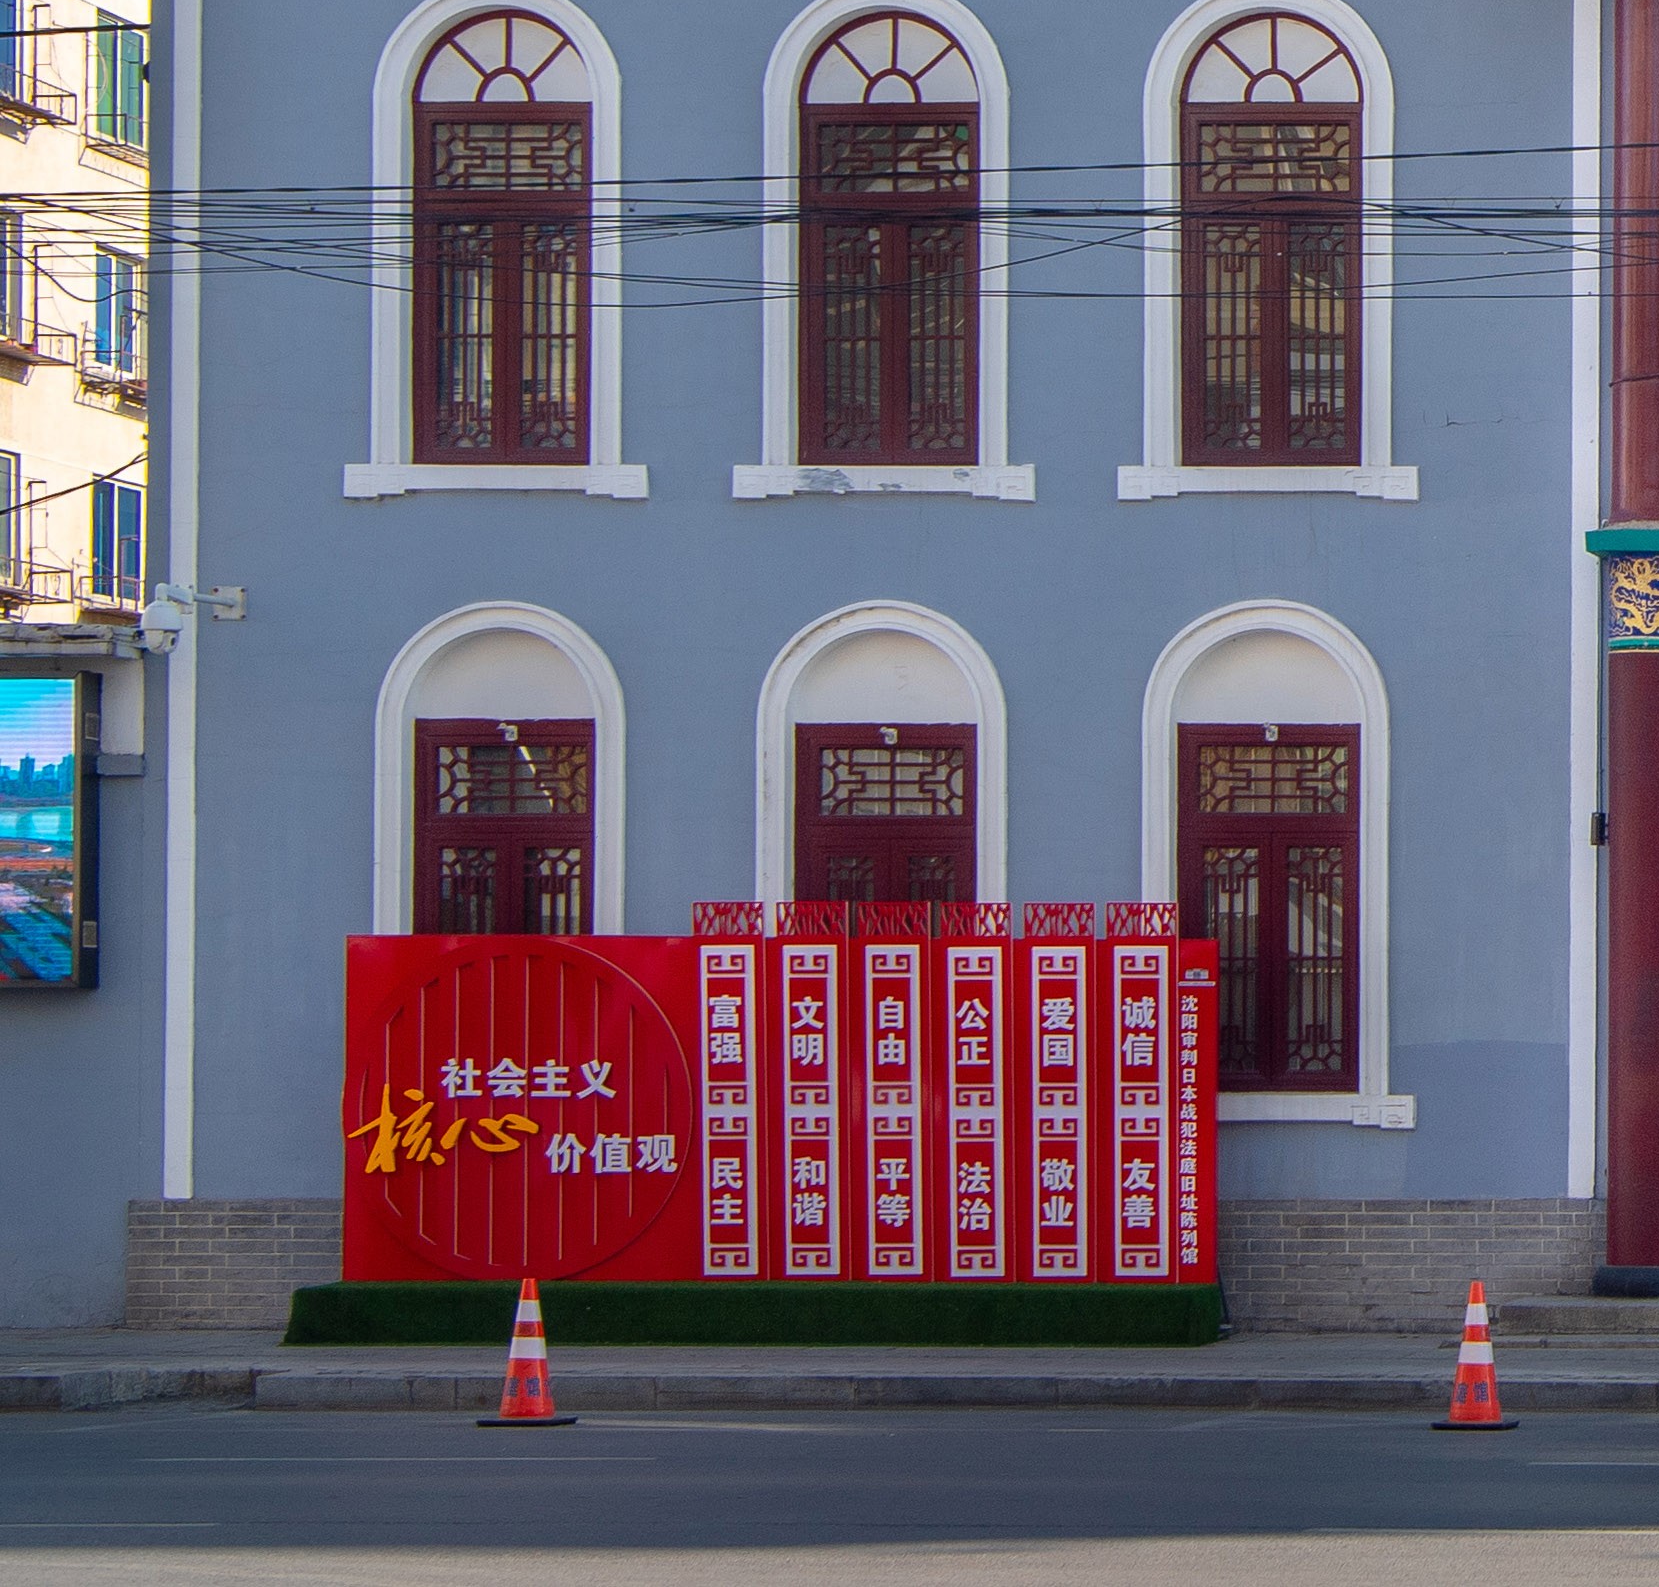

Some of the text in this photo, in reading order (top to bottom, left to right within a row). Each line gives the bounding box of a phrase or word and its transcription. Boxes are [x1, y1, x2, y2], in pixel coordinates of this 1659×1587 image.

[708, 993, 744, 1067] 富强
[791, 994, 825, 1067] 文明
[876, 995, 908, 1067] 自由
[955, 996, 992, 1068] 公正
[1039, 995, 1076, 1068] 爱国
[1121, 994, 1158, 1068] 诚信
[440, 1058, 618, 1100] 社会主义
[347, 1083, 541, 1175] 核心
[545, 1132, 679, 1175] 价值观
[1179, 994, 1199, 1264] 沈阳审判日本战犯法庭旧址陈列馆
[710, 1155, 744, 1227] 民主
[792, 1155, 827, 1228] 和谐
[876, 1156, 910, 1229] 平等
[957, 1160, 993, 1231] 法治
[1040, 1157, 1076, 1230] 敬业
[1121, 1156, 1158, 1230] 友善
